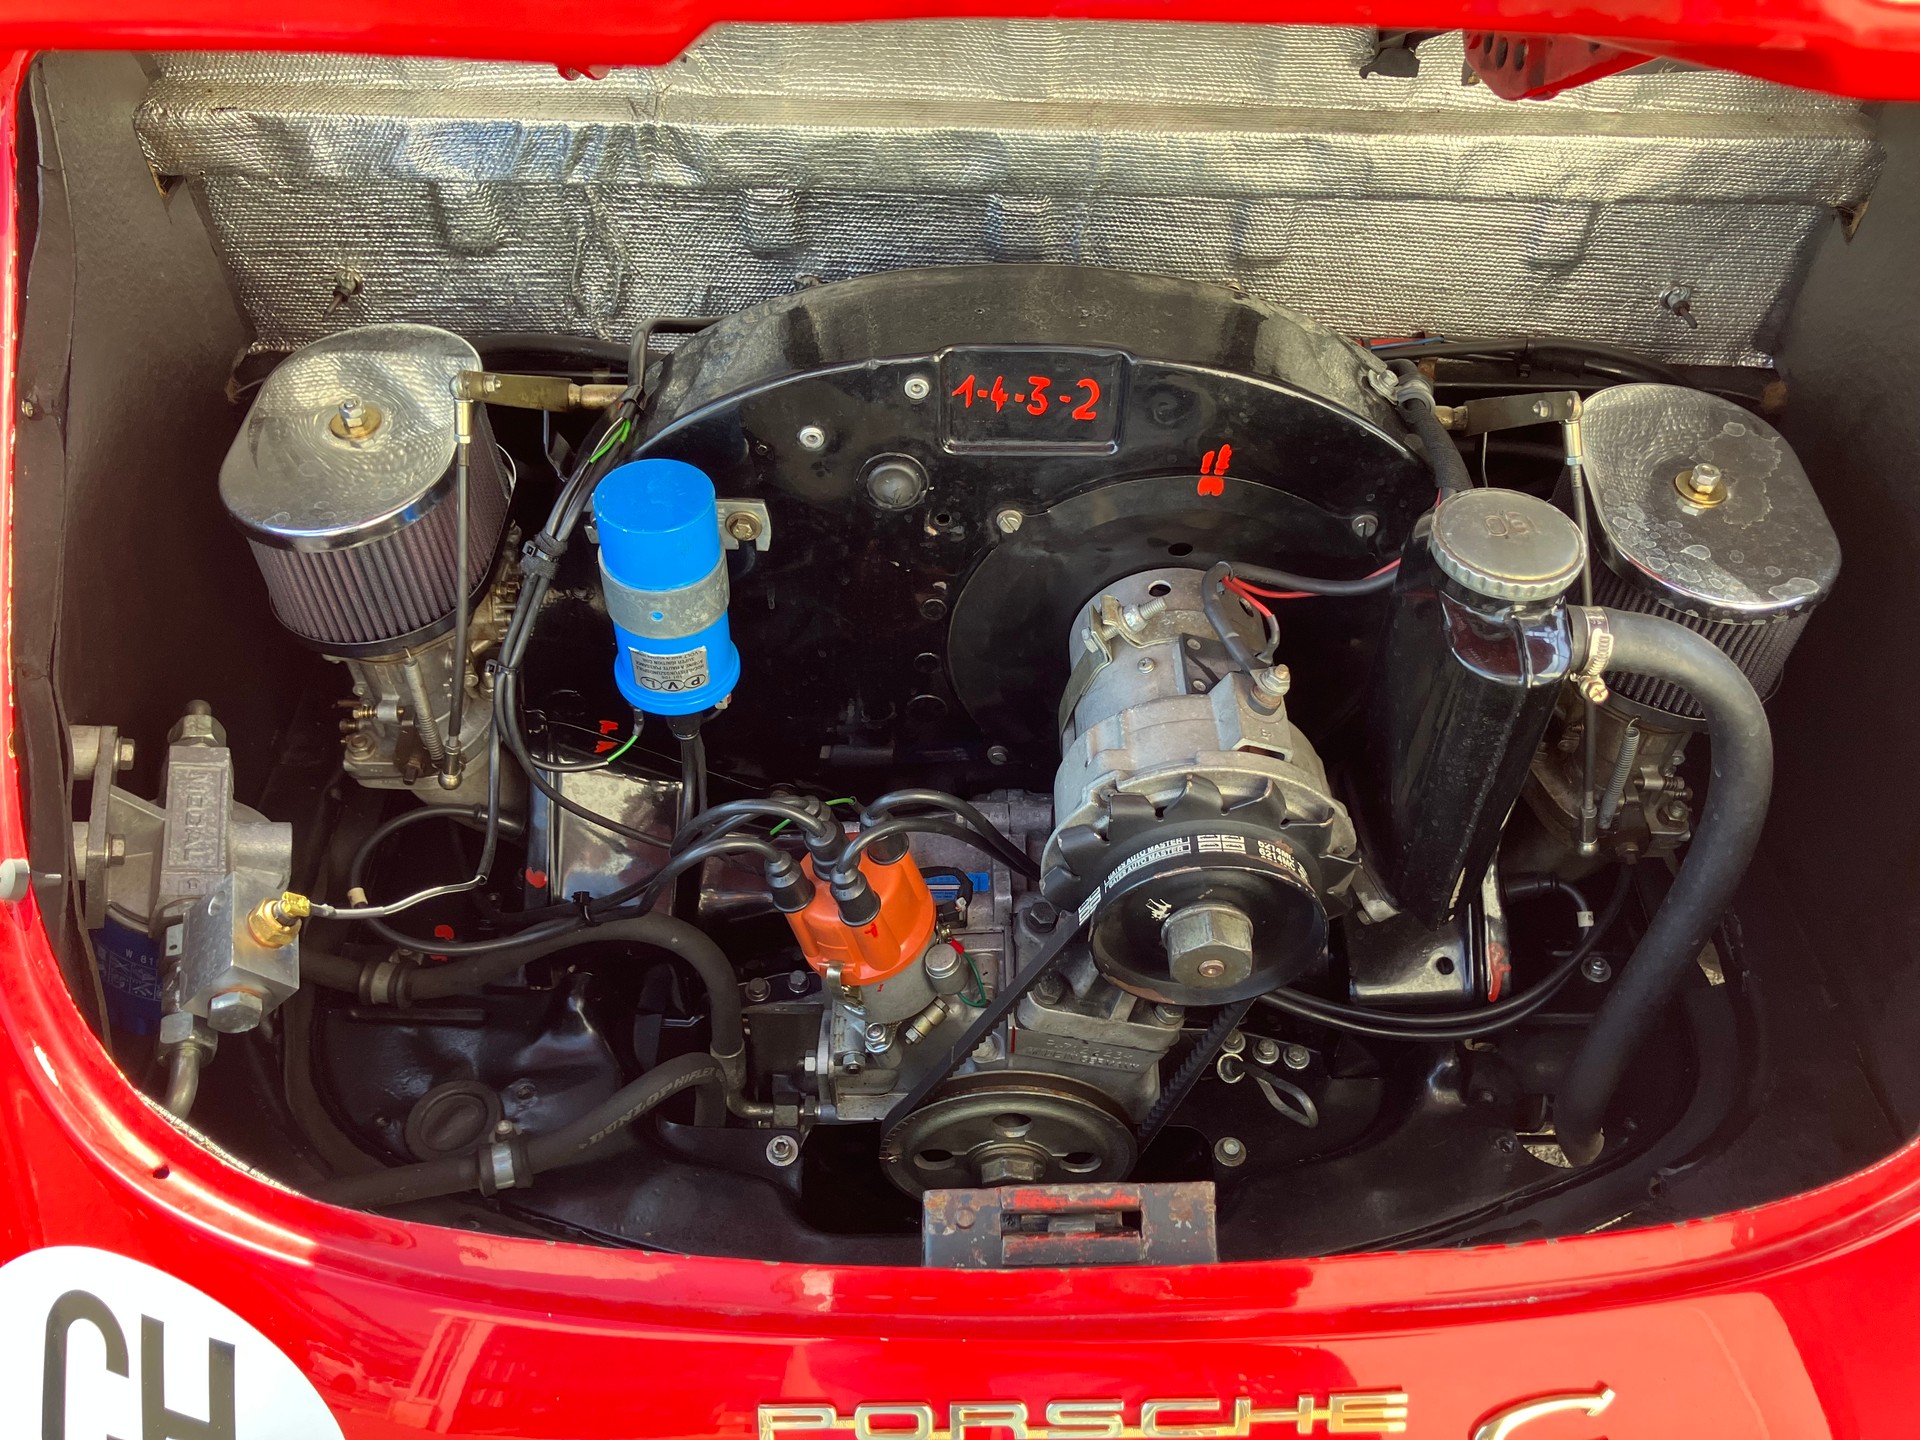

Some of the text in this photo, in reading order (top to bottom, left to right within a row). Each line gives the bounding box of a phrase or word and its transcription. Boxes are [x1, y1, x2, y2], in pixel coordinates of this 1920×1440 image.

[1126, 849, 1146, 863] AUTO
[1147, 837, 1182, 852] MASTER
[1127, 859, 1147, 874] AUTO
[1148, 845, 1183, 861] MASTER
[589, 1082, 673, 1146] DUNLOP
[42, 1289, 236, 1440] CH
[758, 1393, 1409, 1440] PORSCHE
